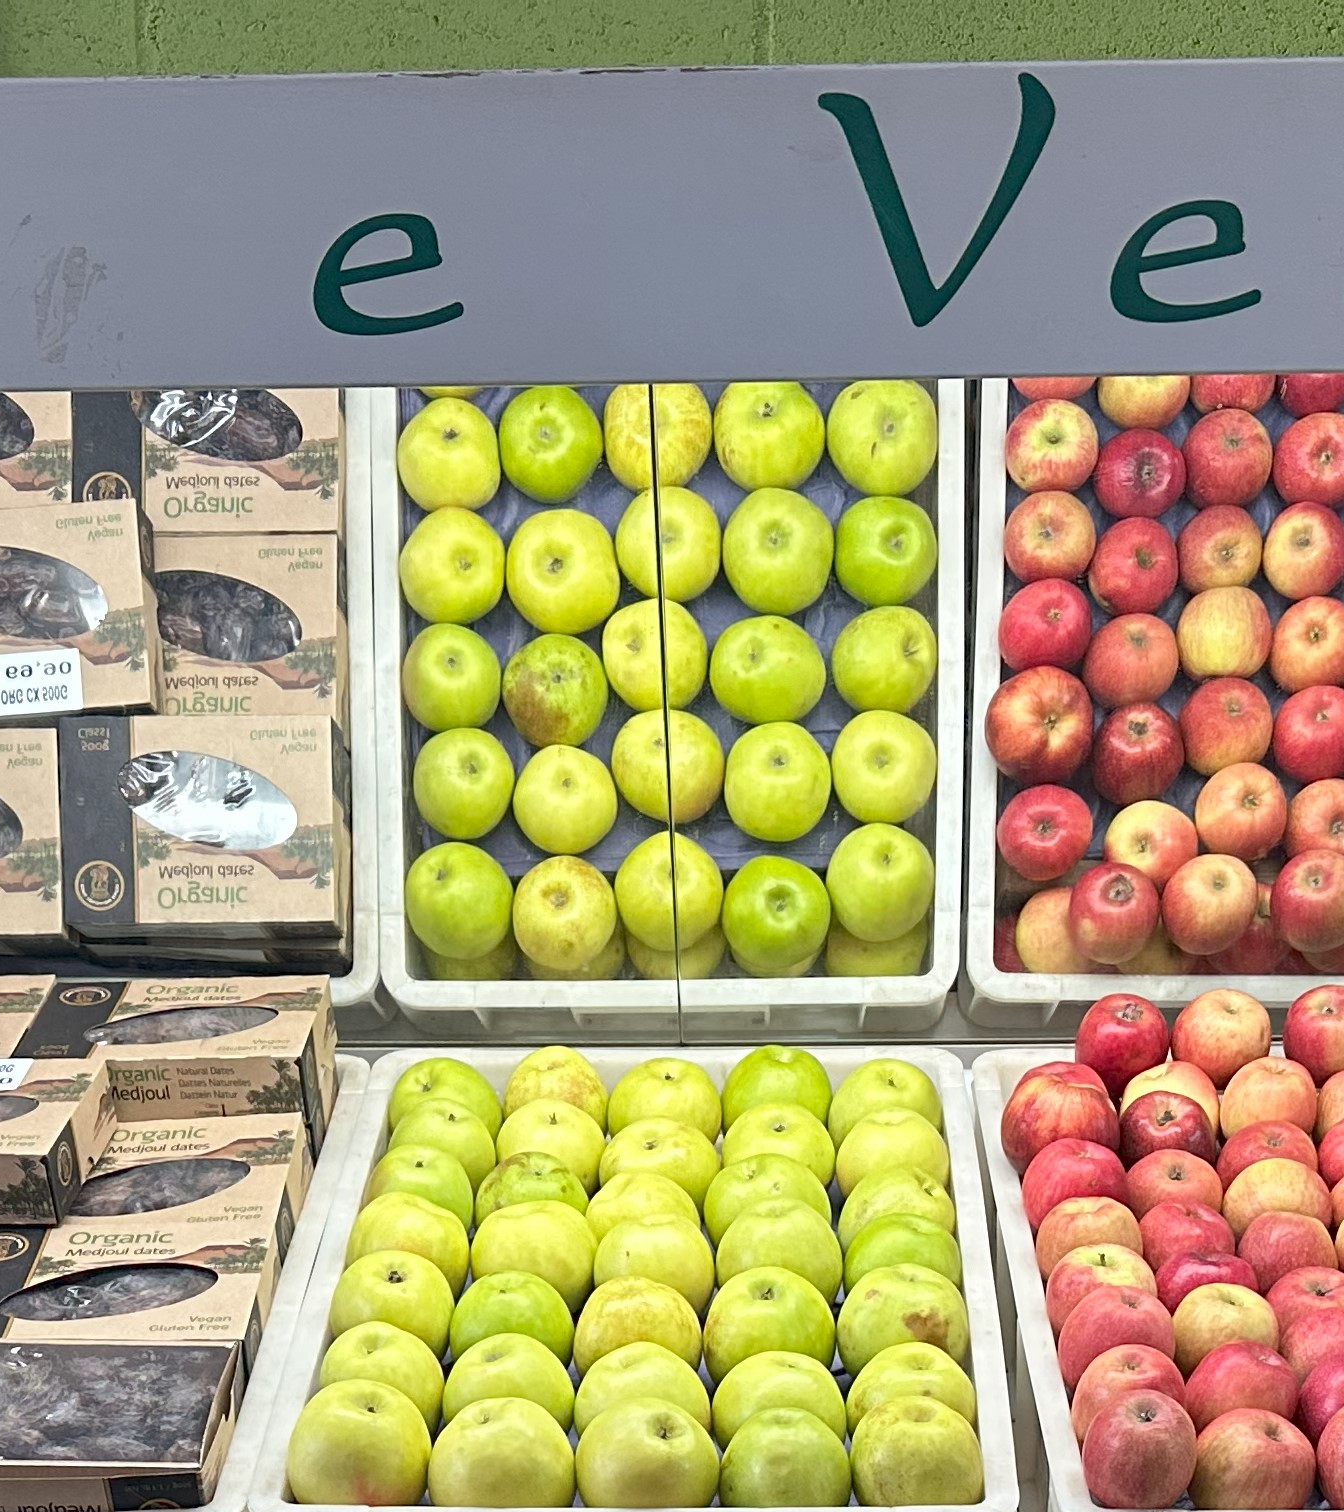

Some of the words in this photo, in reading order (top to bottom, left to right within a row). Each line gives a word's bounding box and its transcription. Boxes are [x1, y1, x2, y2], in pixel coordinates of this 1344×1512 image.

[313, 211, 464, 338] e
[146, 983, 239, 995] Organic
[112, 1127, 207, 1143] Organic
[108, 1143, 166, 1154] Medjoul
[171, 1142, 210, 1151] dates
[69, 1231, 173, 1246] Organic
[65, 1247, 128, 1258] Medjoul
[132, 1246, 176, 1255] dates
